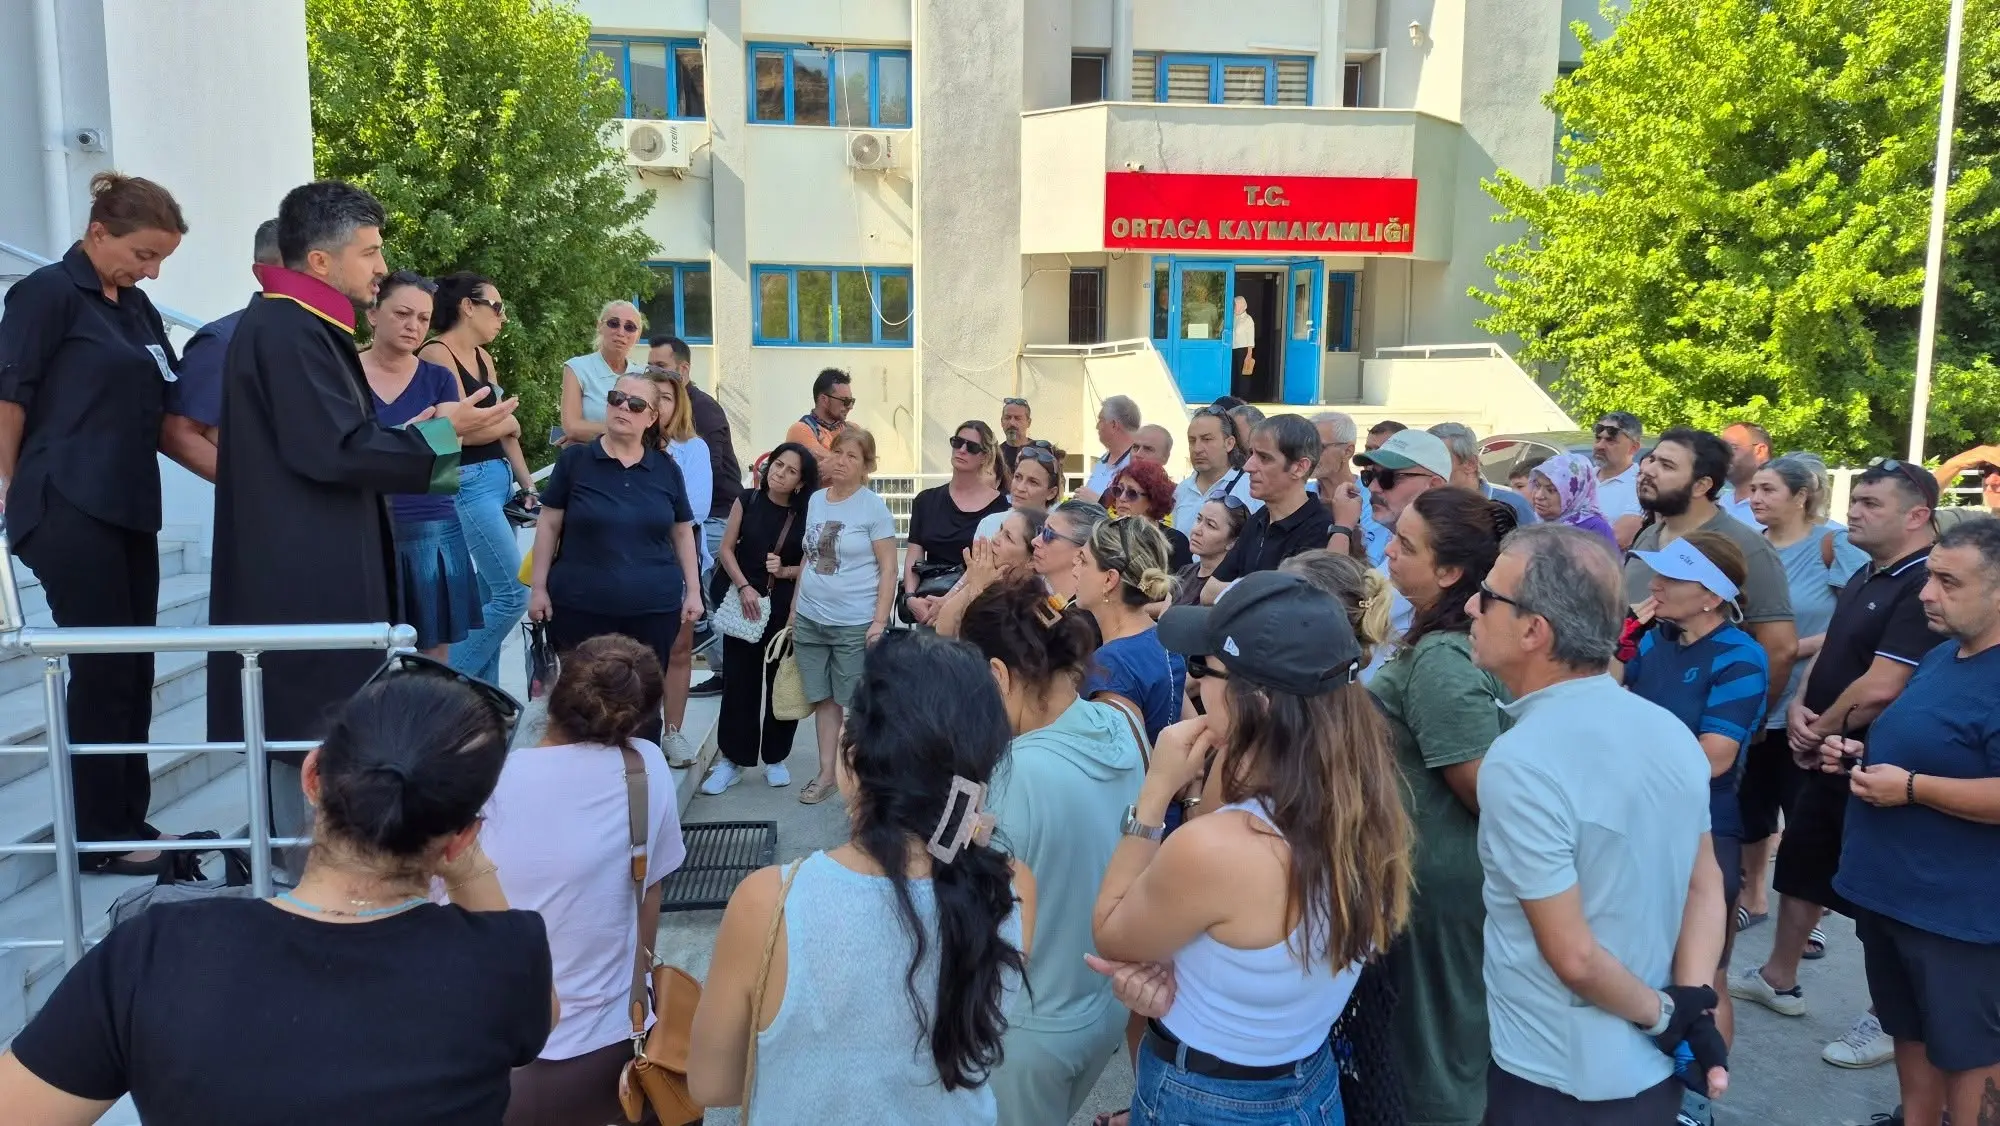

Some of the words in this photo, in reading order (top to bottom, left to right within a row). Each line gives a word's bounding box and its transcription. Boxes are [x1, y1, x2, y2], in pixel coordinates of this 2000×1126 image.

[1243, 185, 1290, 206] T.C.
[1111, 217, 1212, 240] ORTACA
[1218, 217, 1410, 243] KAYMAKAMLIĞI
